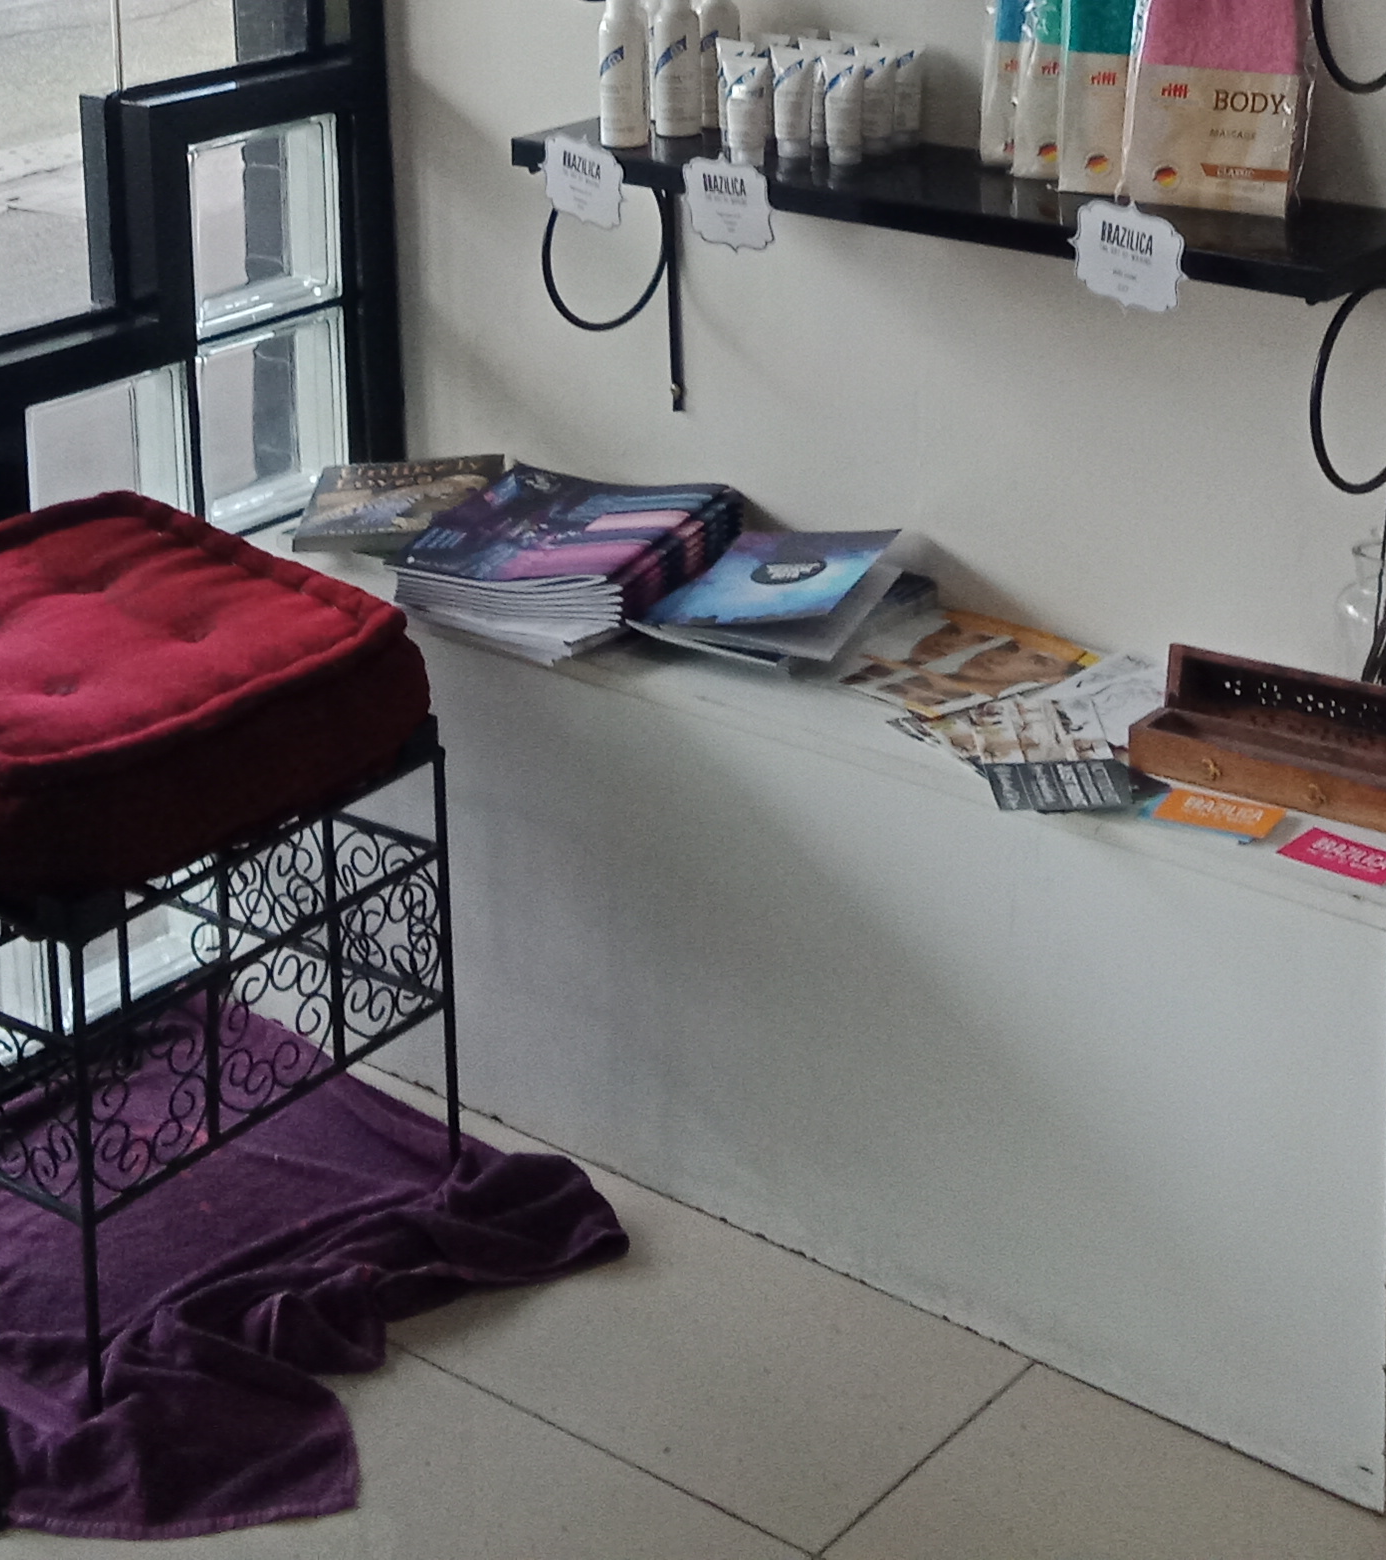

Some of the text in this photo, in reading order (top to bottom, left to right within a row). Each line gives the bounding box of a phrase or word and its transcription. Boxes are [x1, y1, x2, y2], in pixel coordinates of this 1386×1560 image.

[1213, 89, 1286, 115] BODY
[1100, 220, 1153, 257] BRAZILICA
[1182, 795, 1264, 822] BRAZILICA
